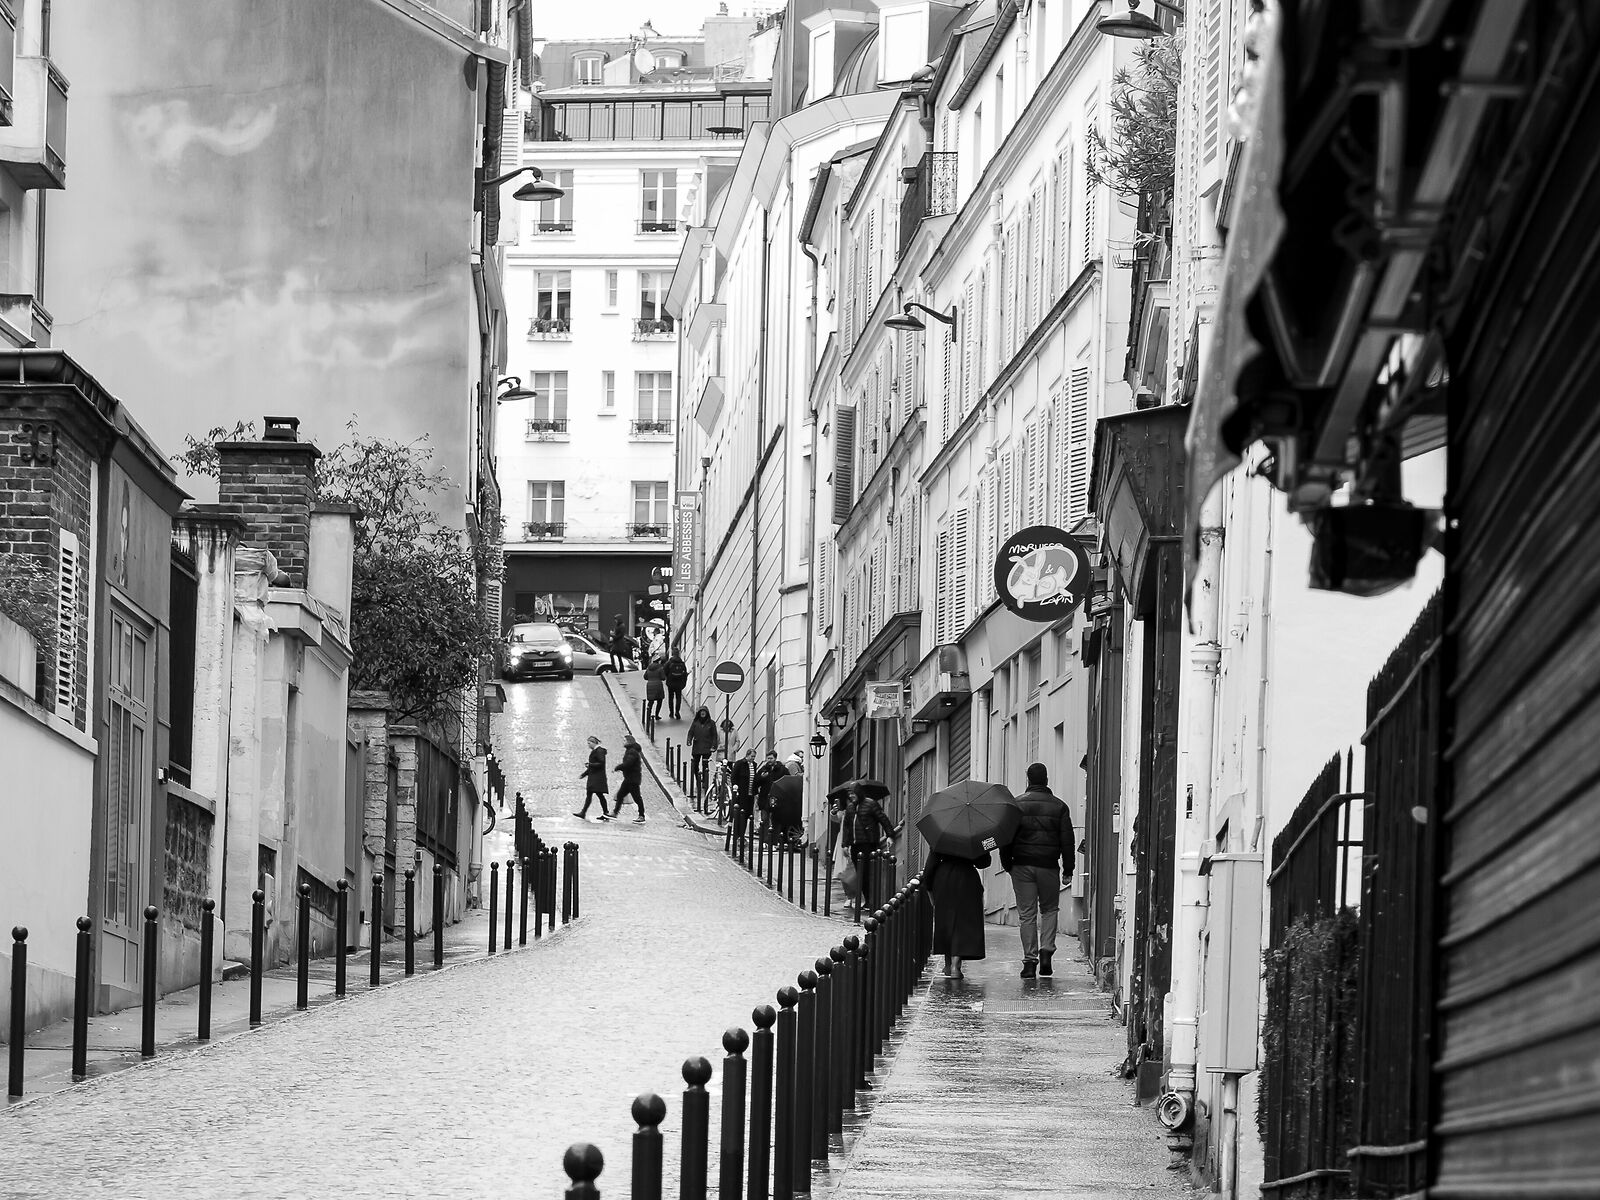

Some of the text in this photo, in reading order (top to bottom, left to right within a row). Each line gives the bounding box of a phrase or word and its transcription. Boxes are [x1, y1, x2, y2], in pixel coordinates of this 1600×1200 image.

[681, 511, 693, 580] LES ABBESSES
[1045, 564, 1054, 574] &
